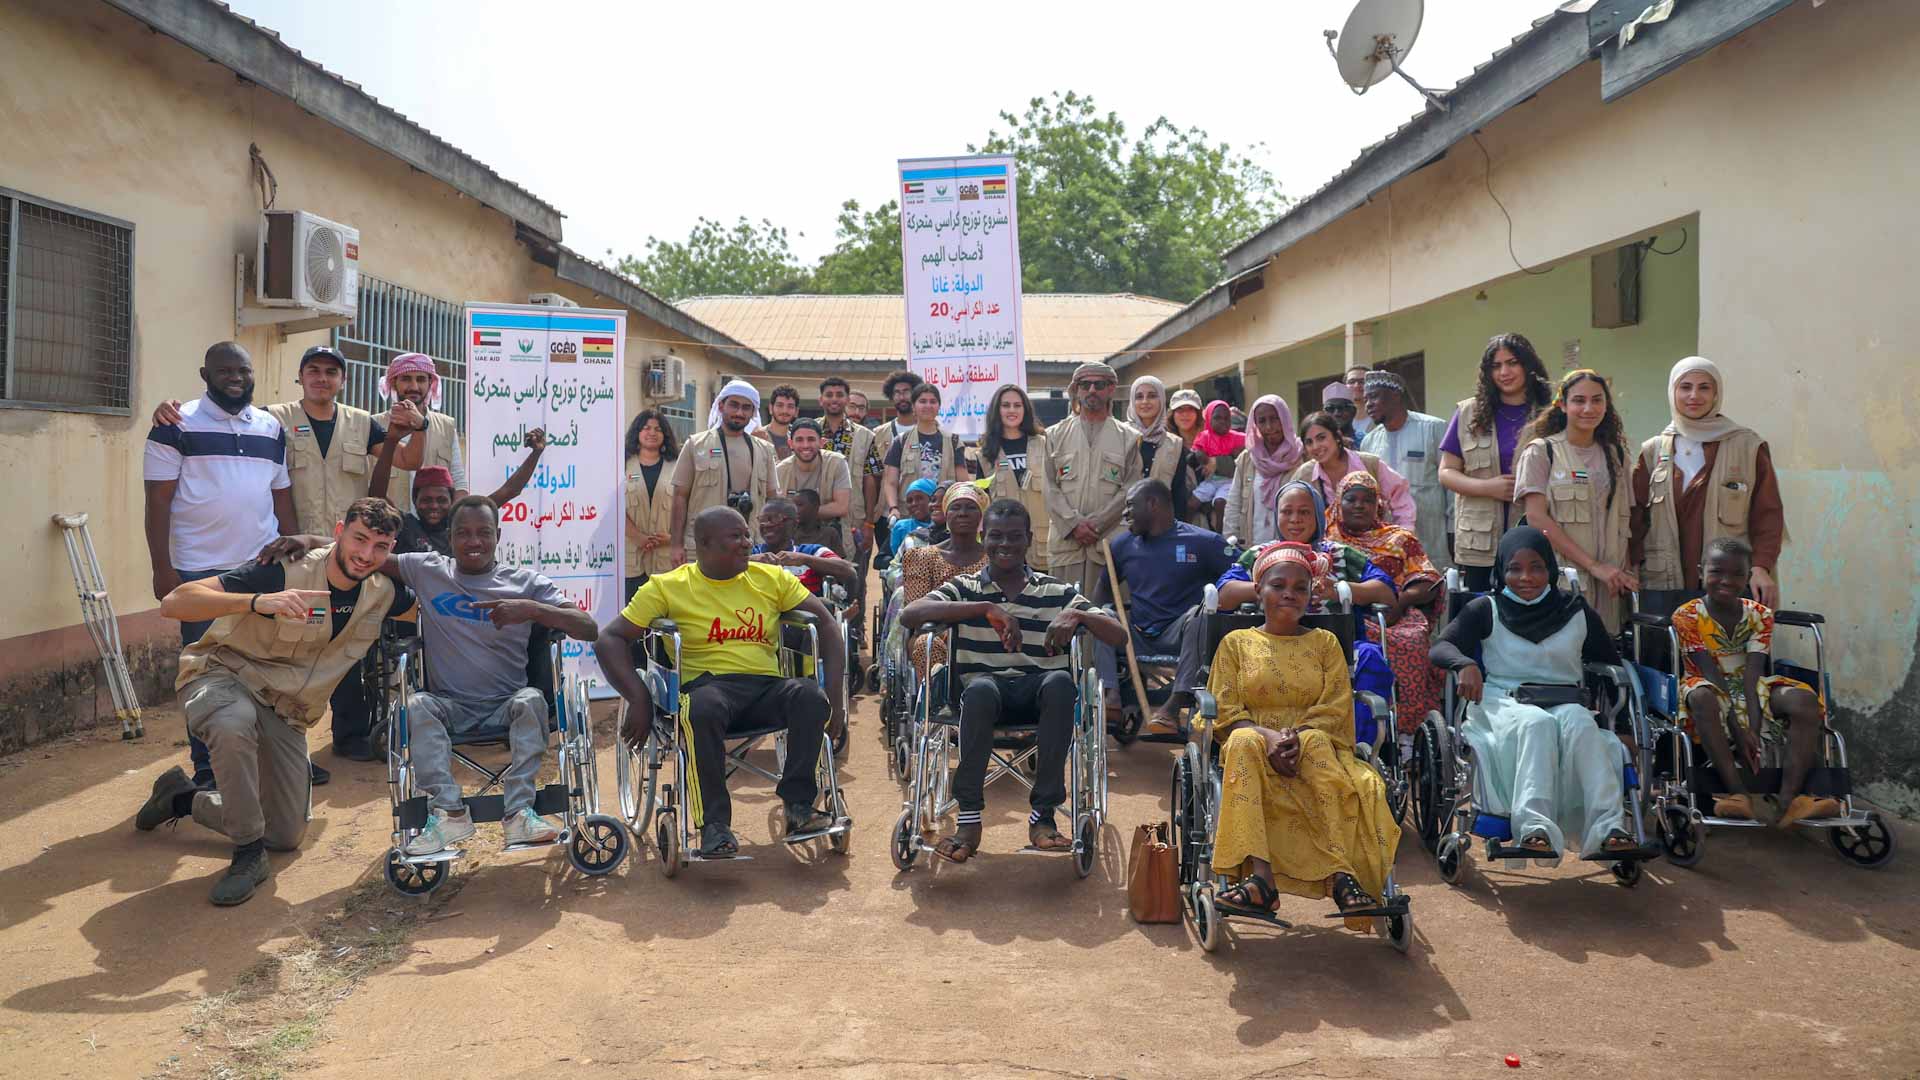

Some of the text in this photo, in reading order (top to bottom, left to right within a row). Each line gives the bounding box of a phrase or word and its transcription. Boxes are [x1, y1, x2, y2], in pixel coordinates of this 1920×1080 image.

[907, 208, 1008, 237] مشروع توزيع كراسي متحركة
[921, 240, 983, 271] لأصحاب الهمم
[932, 275, 949, 293] غانا
[987, 302, 1000, 315] عدد
[583, 357, 612, 365] GHANA
[473, 372, 614, 412] مشروع توزيع كراسي متحركة
[579, 504, 597, 521] عدد
